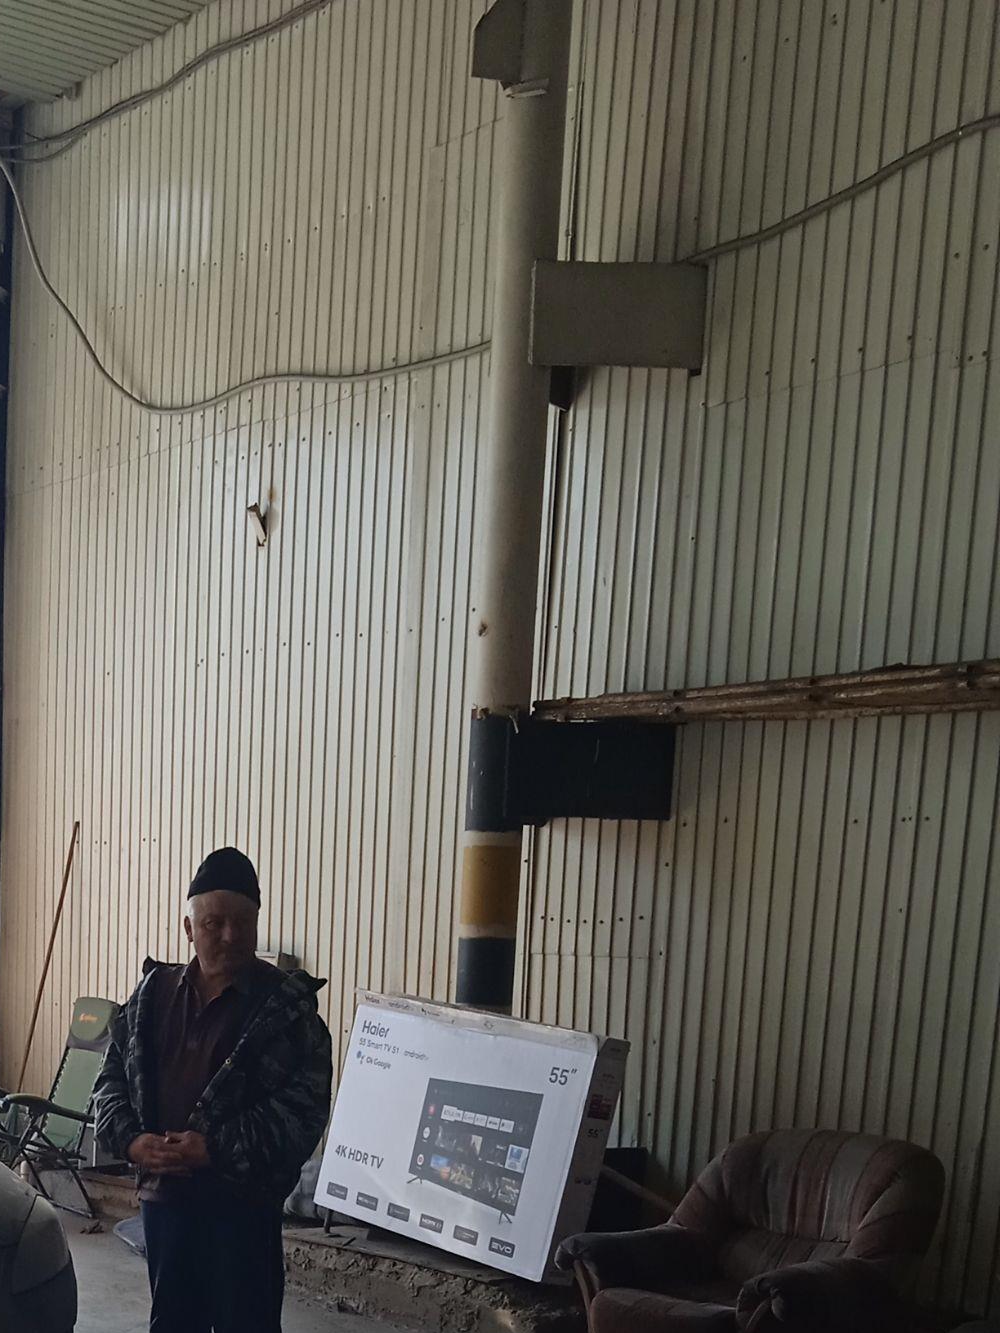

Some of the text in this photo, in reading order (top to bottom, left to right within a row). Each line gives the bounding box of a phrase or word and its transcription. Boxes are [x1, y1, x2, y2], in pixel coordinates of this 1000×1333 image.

[362, 1020, 390, 1038] Haier
[383, 1043, 392, 1053] TV
[335, 1144, 384, 1169] 4K HDR TV
